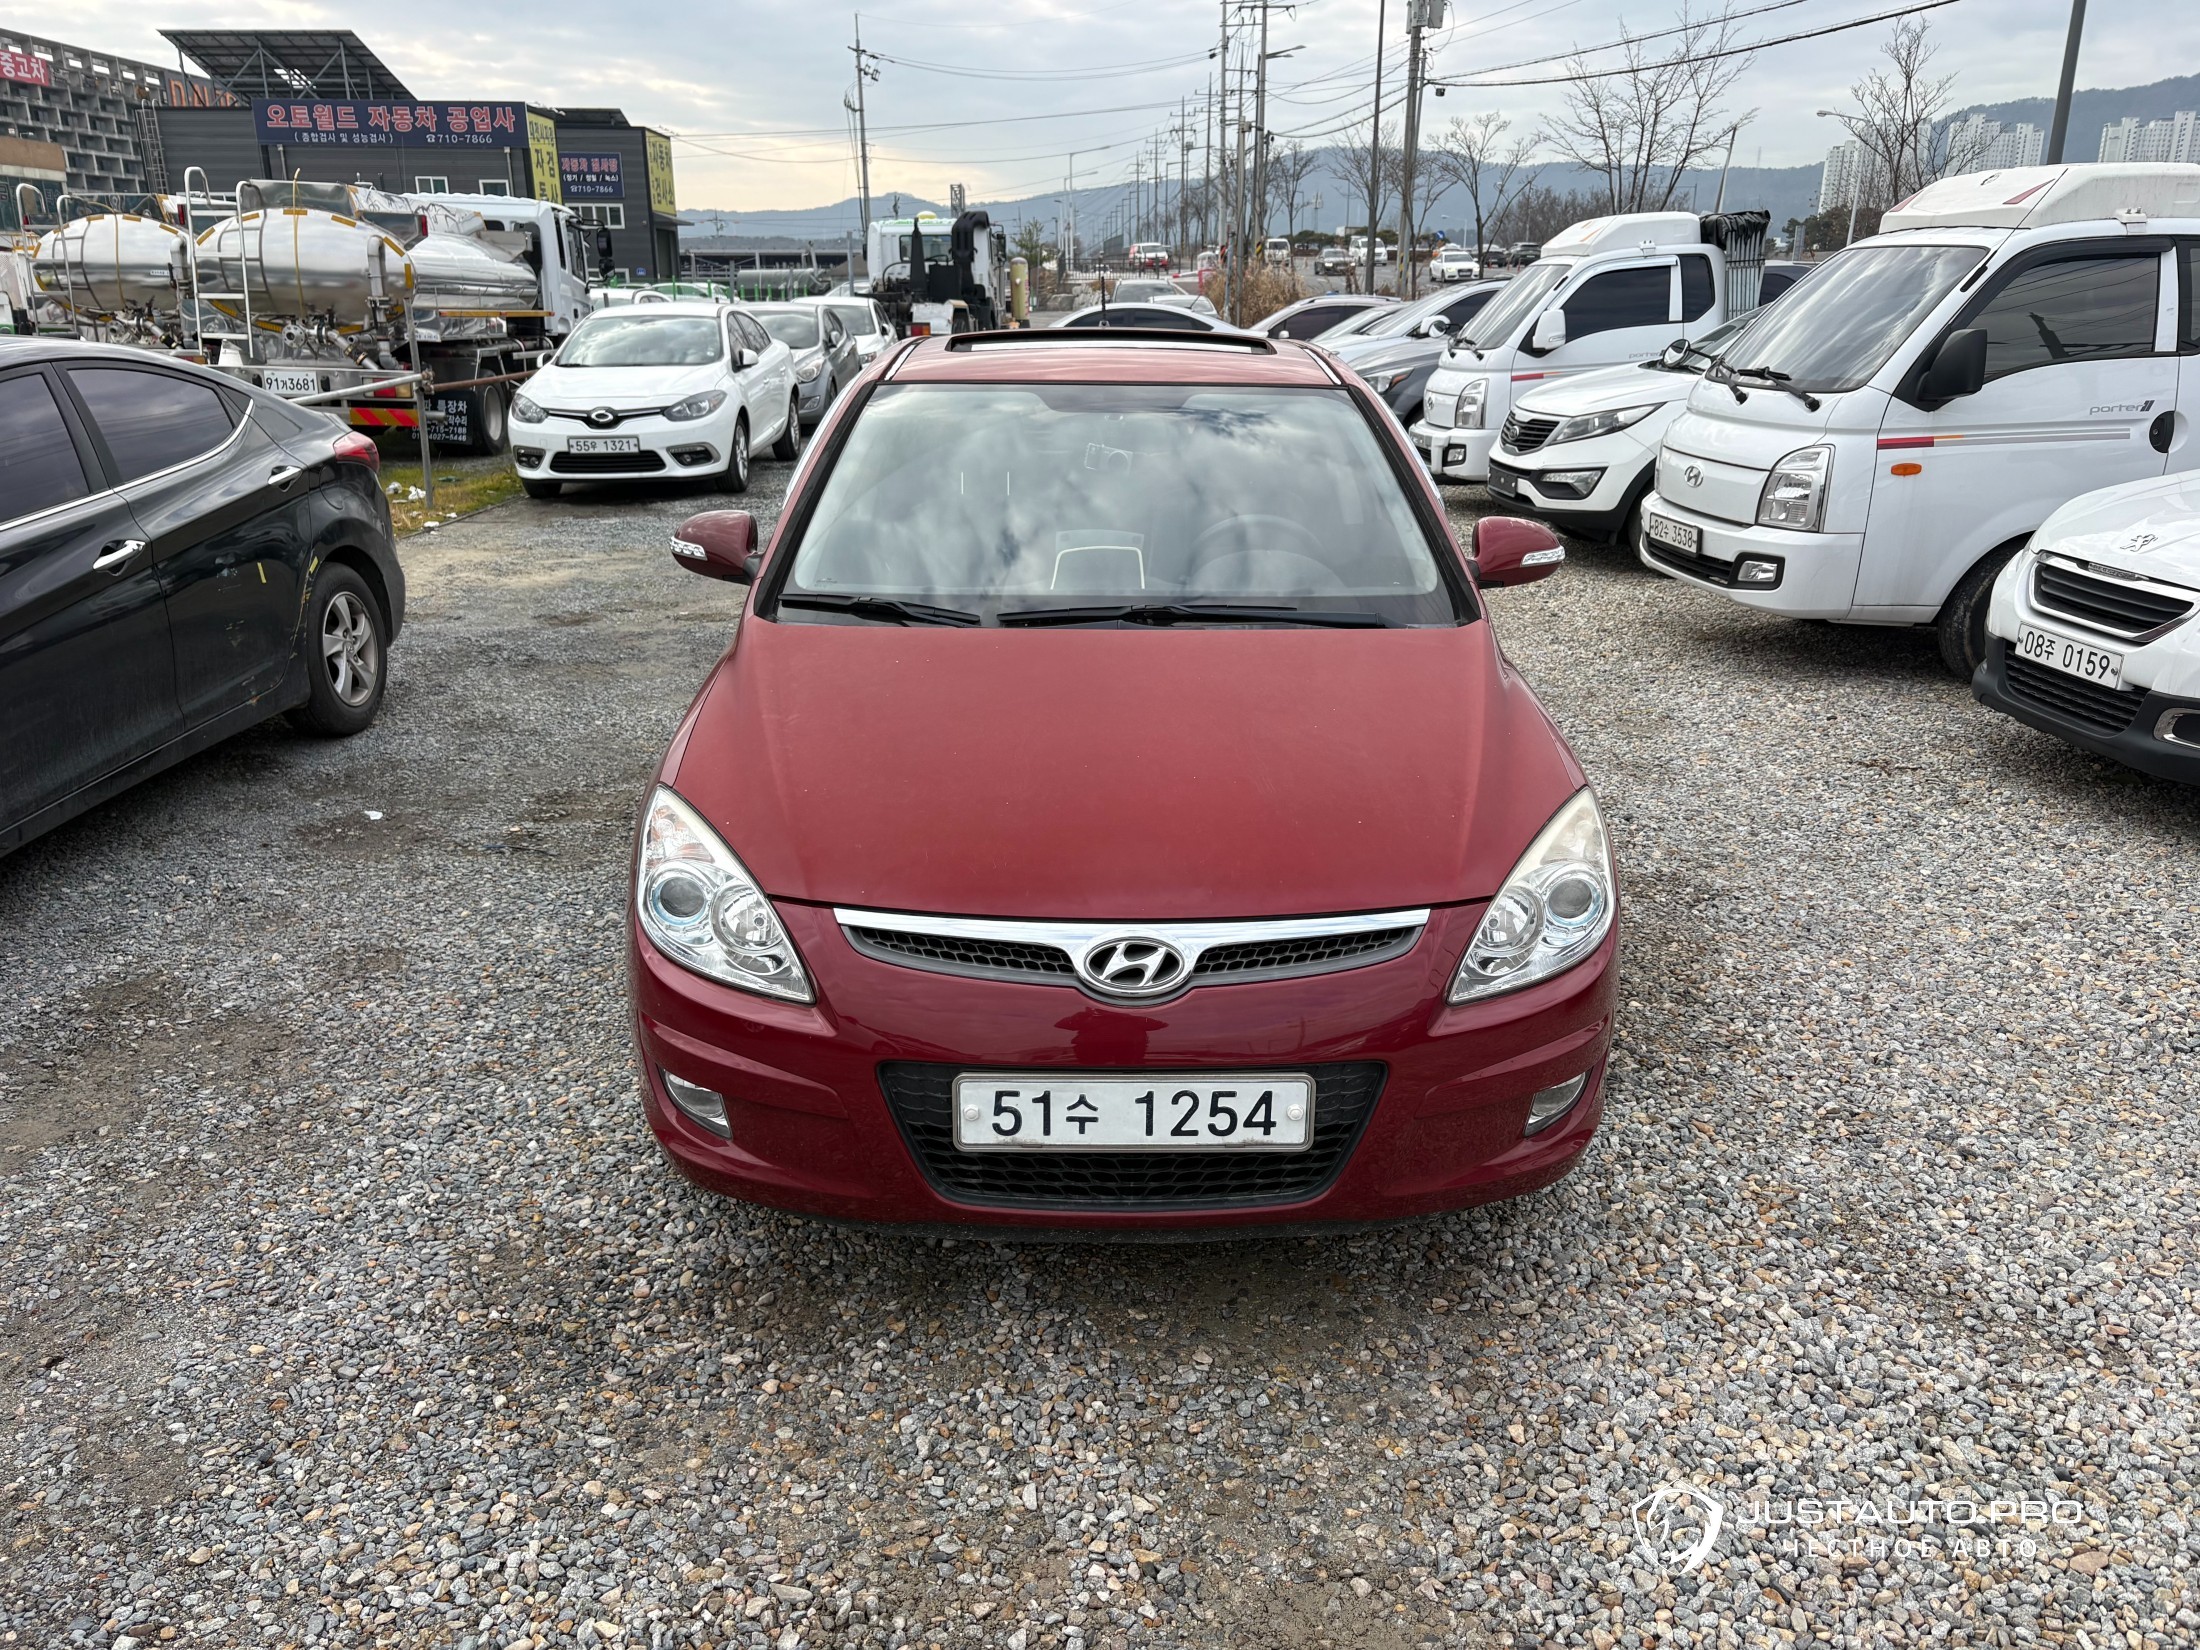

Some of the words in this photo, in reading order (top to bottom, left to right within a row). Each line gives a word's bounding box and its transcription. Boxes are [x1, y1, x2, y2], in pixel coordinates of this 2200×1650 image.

[0, 52, 45, 83] 중고차
[267, 104, 358, 130] 오토월드
[368, 105, 437, 132] 자동차
[447, 106, 515, 133] 공업사
[437, 134, 493, 144] 710-7866
[578, 185, 613, 193] 710-7866
[265, 376, 316, 392] 91거3681
[603, 440, 631, 451] 1321
[1654, 519, 1669, 538] 82수
[1672, 525, 1693, 548] 3538
[2024, 631, 2056, 660] 08주
[2062, 644, 2110, 679] 0159
[991, 1090, 1099, 1136] 51수
[1134, 1090, 1277, 1136] 1254
